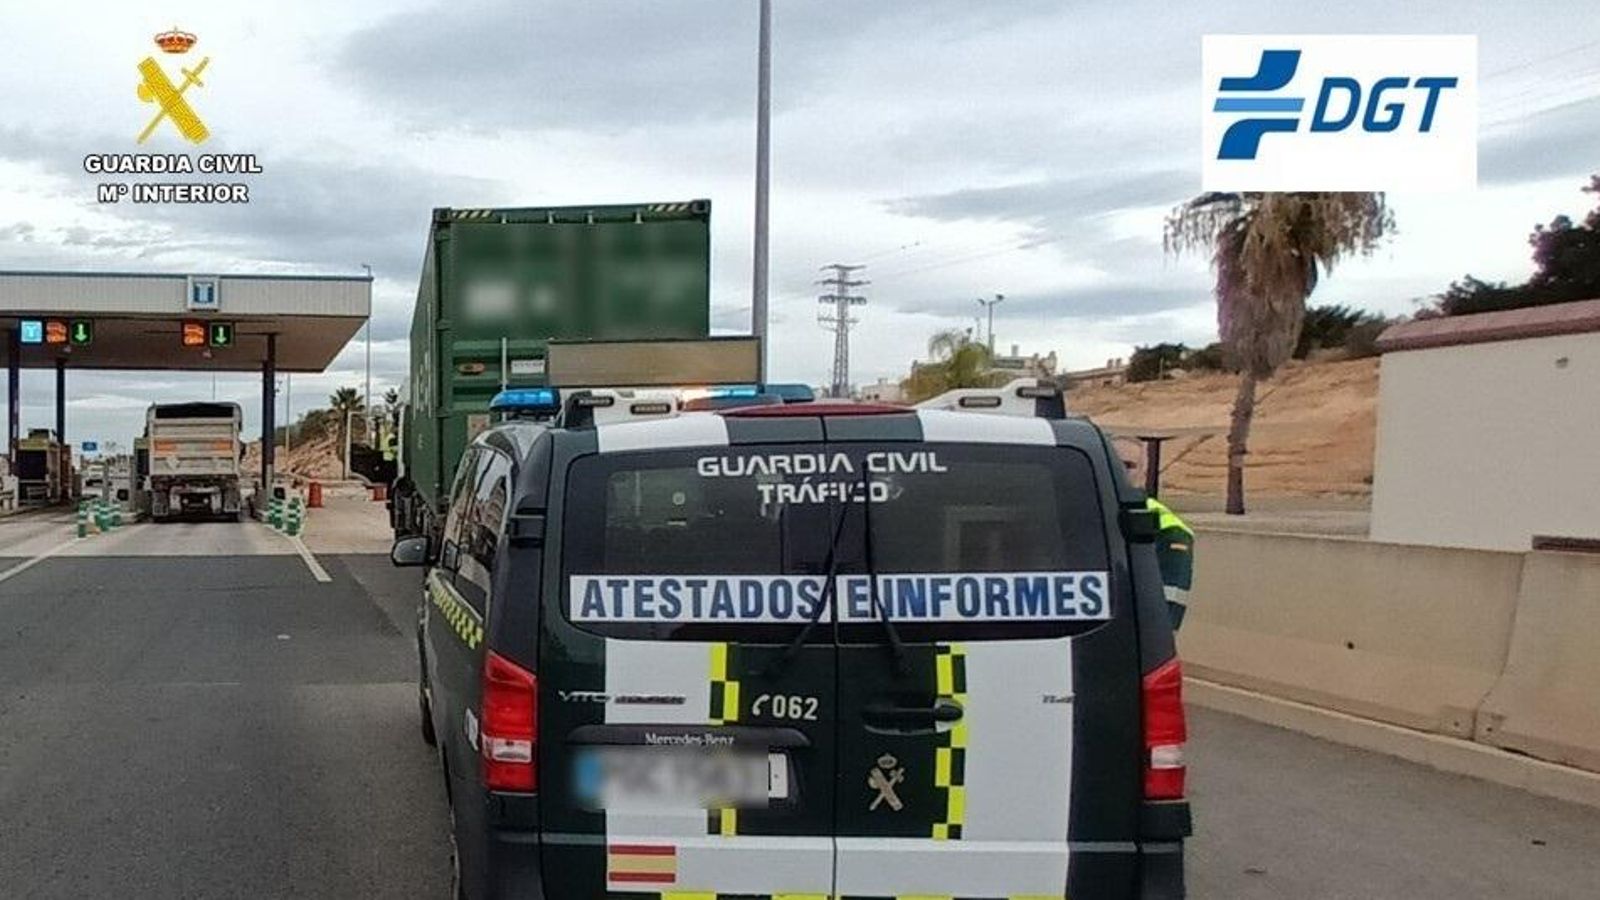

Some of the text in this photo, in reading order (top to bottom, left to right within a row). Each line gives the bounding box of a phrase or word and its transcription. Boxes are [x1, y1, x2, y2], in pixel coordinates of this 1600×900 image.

[697, 451, 948, 477] GUARDIA CIVIL
[580, 574, 1104, 620] ATESTADOS E INFORMES
[771, 695, 819, 721] 062
[644, 732, 735, 747] Mercedes-Benz
